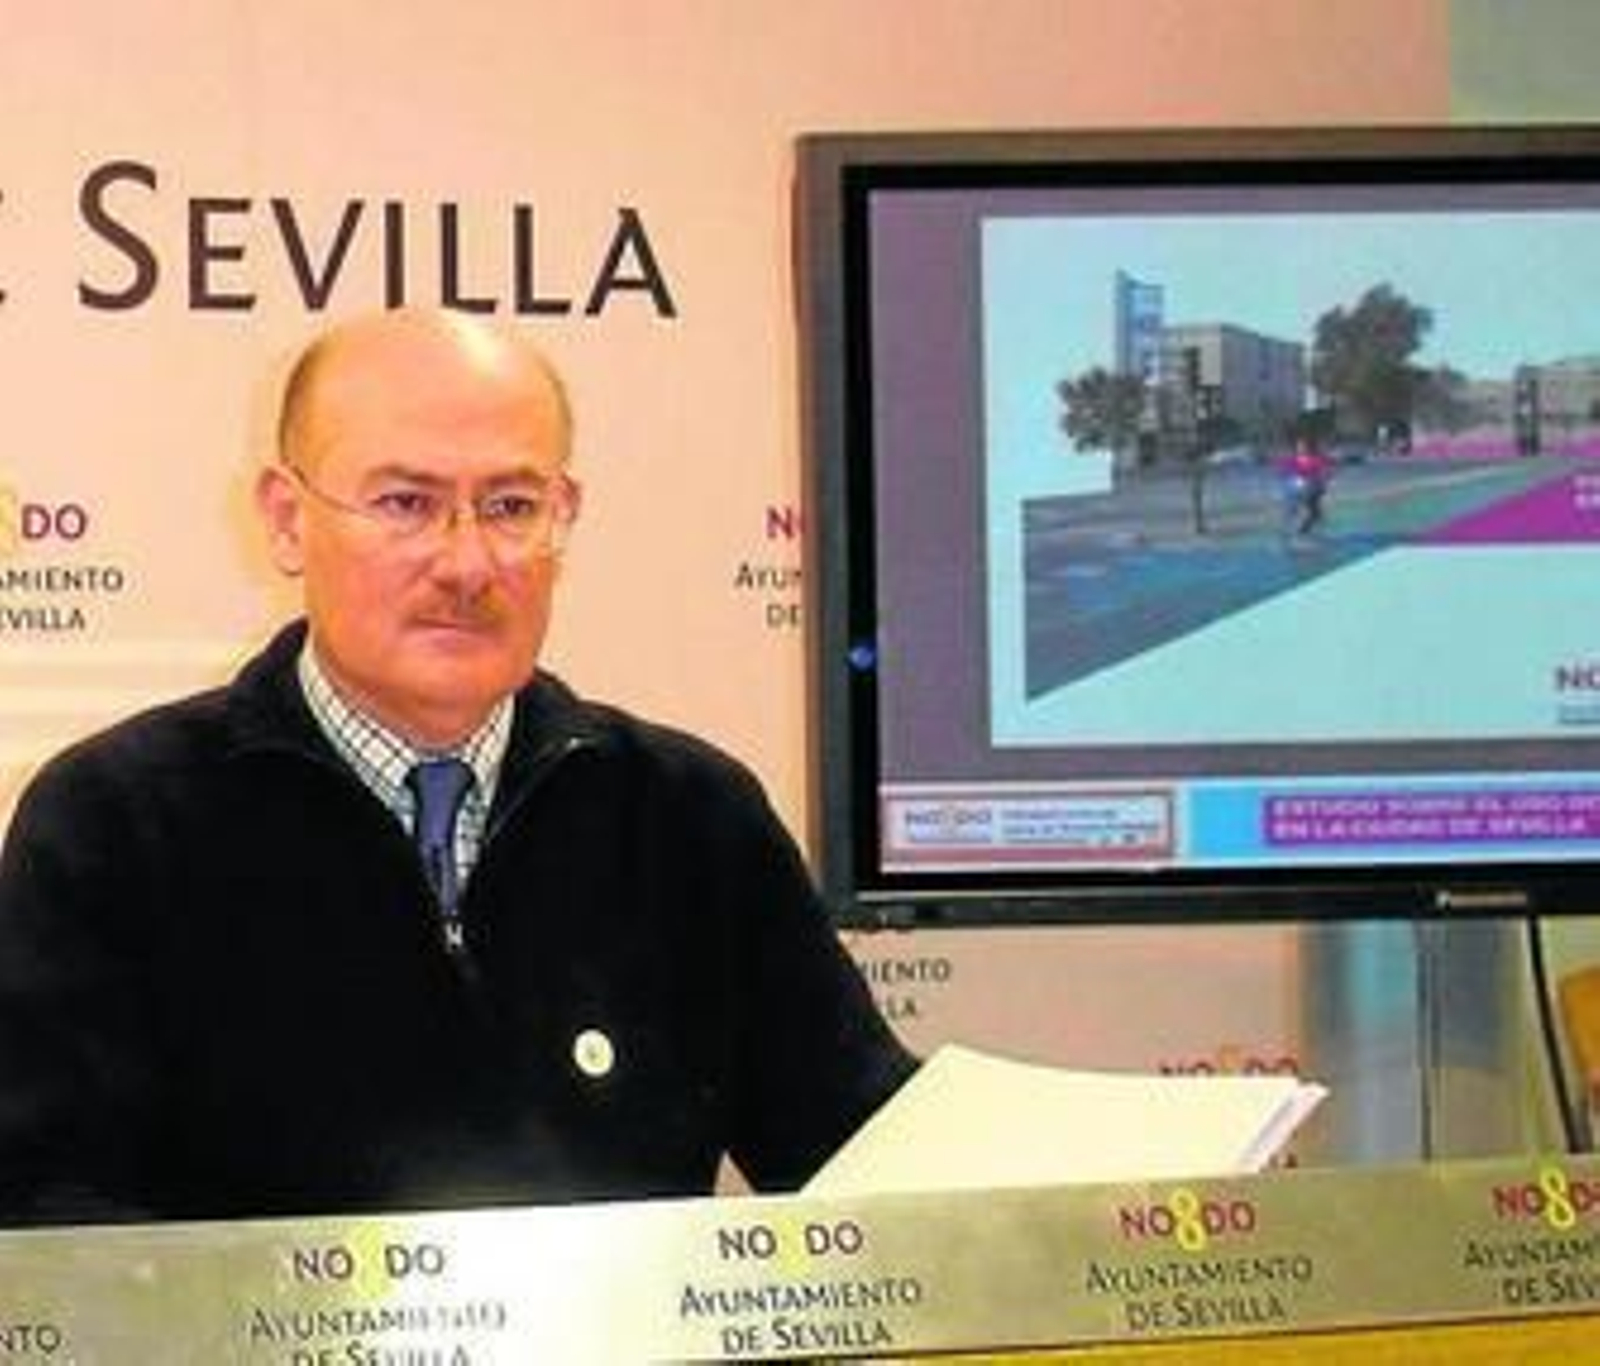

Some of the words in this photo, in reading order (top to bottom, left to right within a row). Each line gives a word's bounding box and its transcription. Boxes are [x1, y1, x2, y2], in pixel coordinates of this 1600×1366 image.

[78, 161, 678, 319] SEVILLA
[0, 566, 124, 592] MIENTO
[0, 607, 86, 631] VILLA
[1086, 1254, 1313, 1295] AYUNTAMIENTO
[679, 1278, 923, 1317] AYUNTAMIENTO
[1126, 1301, 1168, 1331] DE
[1171, 1292, 1285, 1328] SEVILLA
[721, 1325, 765, 1355] DE
[770, 1316, 894, 1352] SEVILLA
